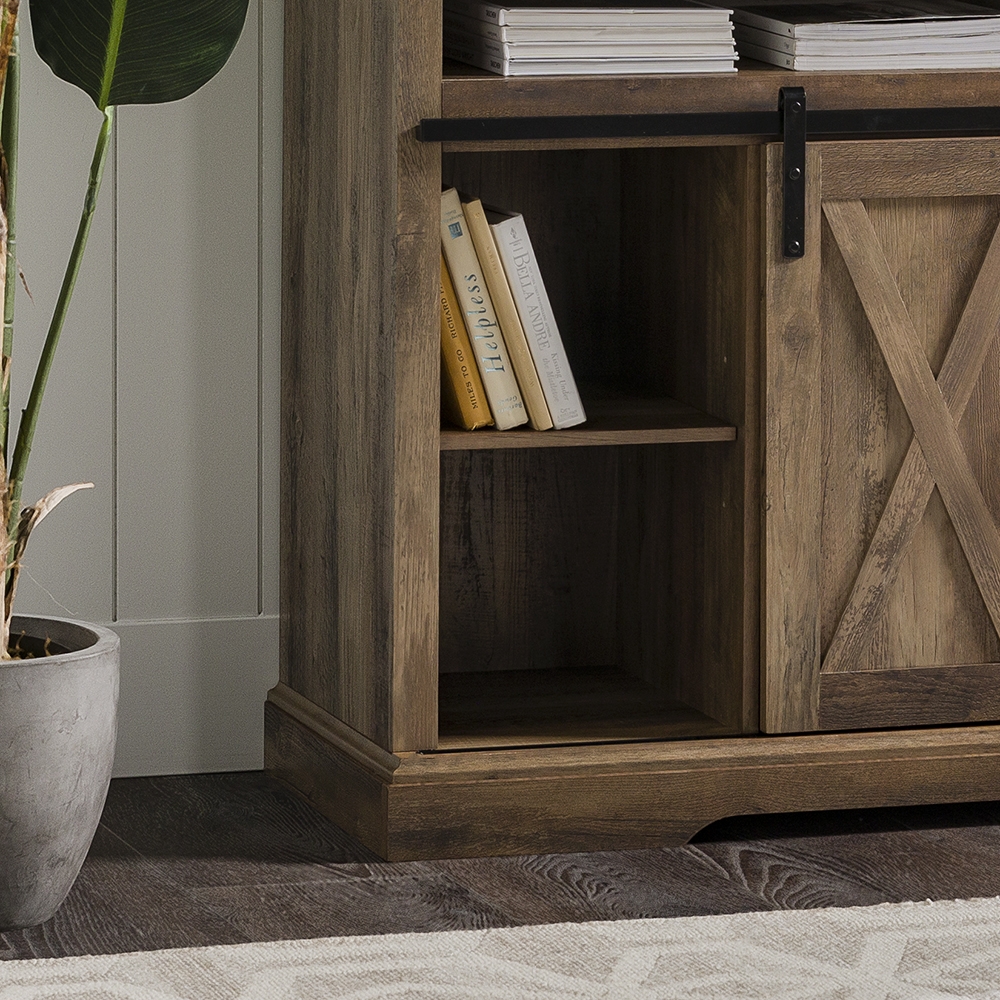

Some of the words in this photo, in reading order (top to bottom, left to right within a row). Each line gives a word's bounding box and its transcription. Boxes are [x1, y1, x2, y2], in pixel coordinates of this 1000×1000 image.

[440, 298, 458, 339] RICHARD
[513, 251, 535, 301] BELLA
[527, 304, 551, 351] ANDRE
[464, 273, 506, 374] Helpless
[455, 349, 465, 362] GO
[460, 365, 469, 379] TO
[542, 357, 552, 371] the
[551, 352, 564, 379] Kissing
[560, 379, 570, 401] Under
[465, 380, 479, 410] MILES
